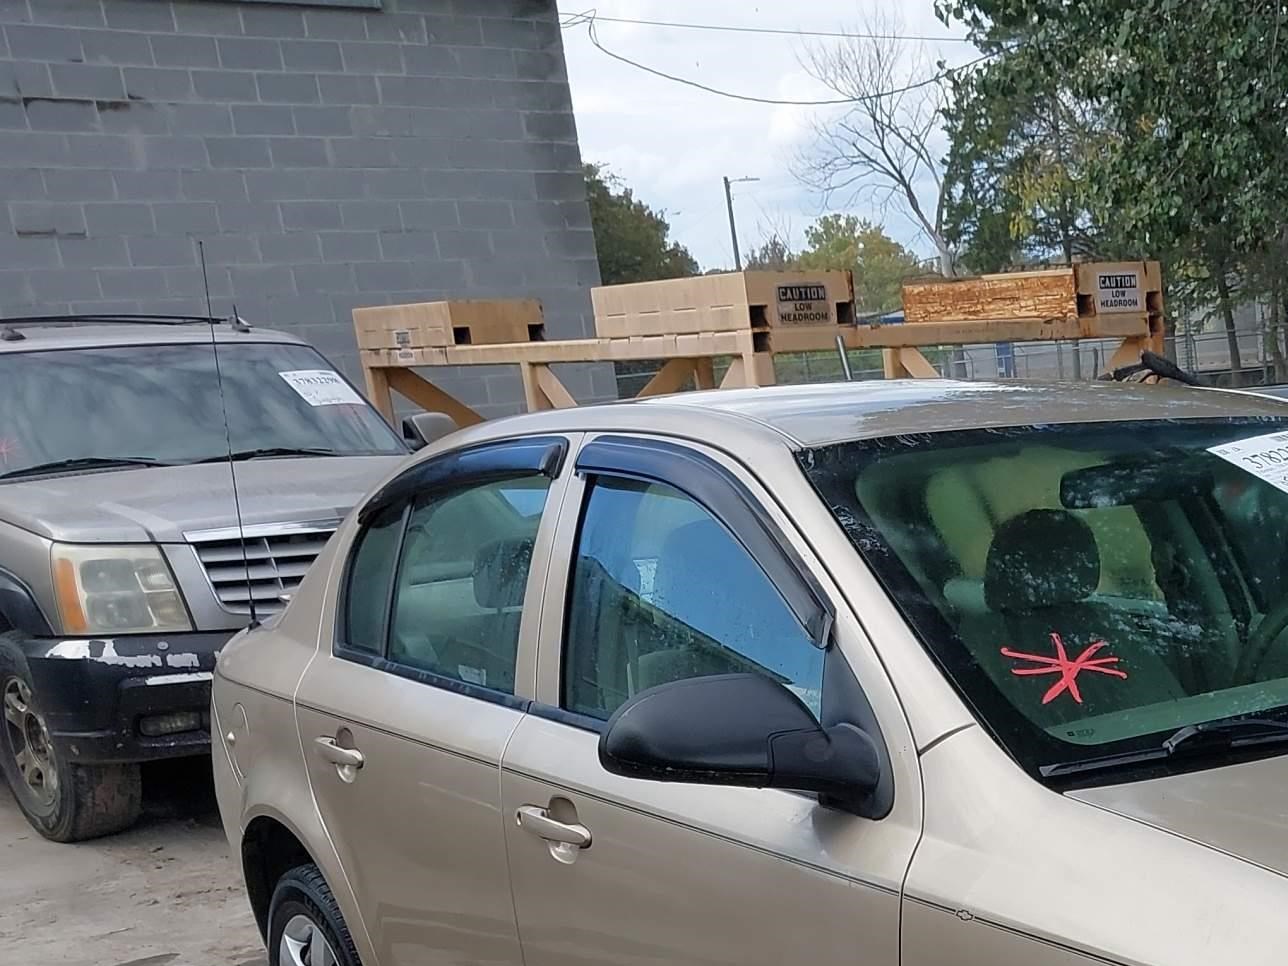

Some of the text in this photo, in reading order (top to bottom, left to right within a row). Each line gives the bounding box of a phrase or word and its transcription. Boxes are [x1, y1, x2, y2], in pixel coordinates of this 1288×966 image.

[1099, 275, 1137, 288] CAUTION
[779, 287, 825, 300] CAUTION
[1111, 290, 1126, 298] LOW
[794, 303, 812, 311] LOW
[1100, 299, 1138, 308] HEADROOM
[780, 312, 828, 322] HEADROOM
